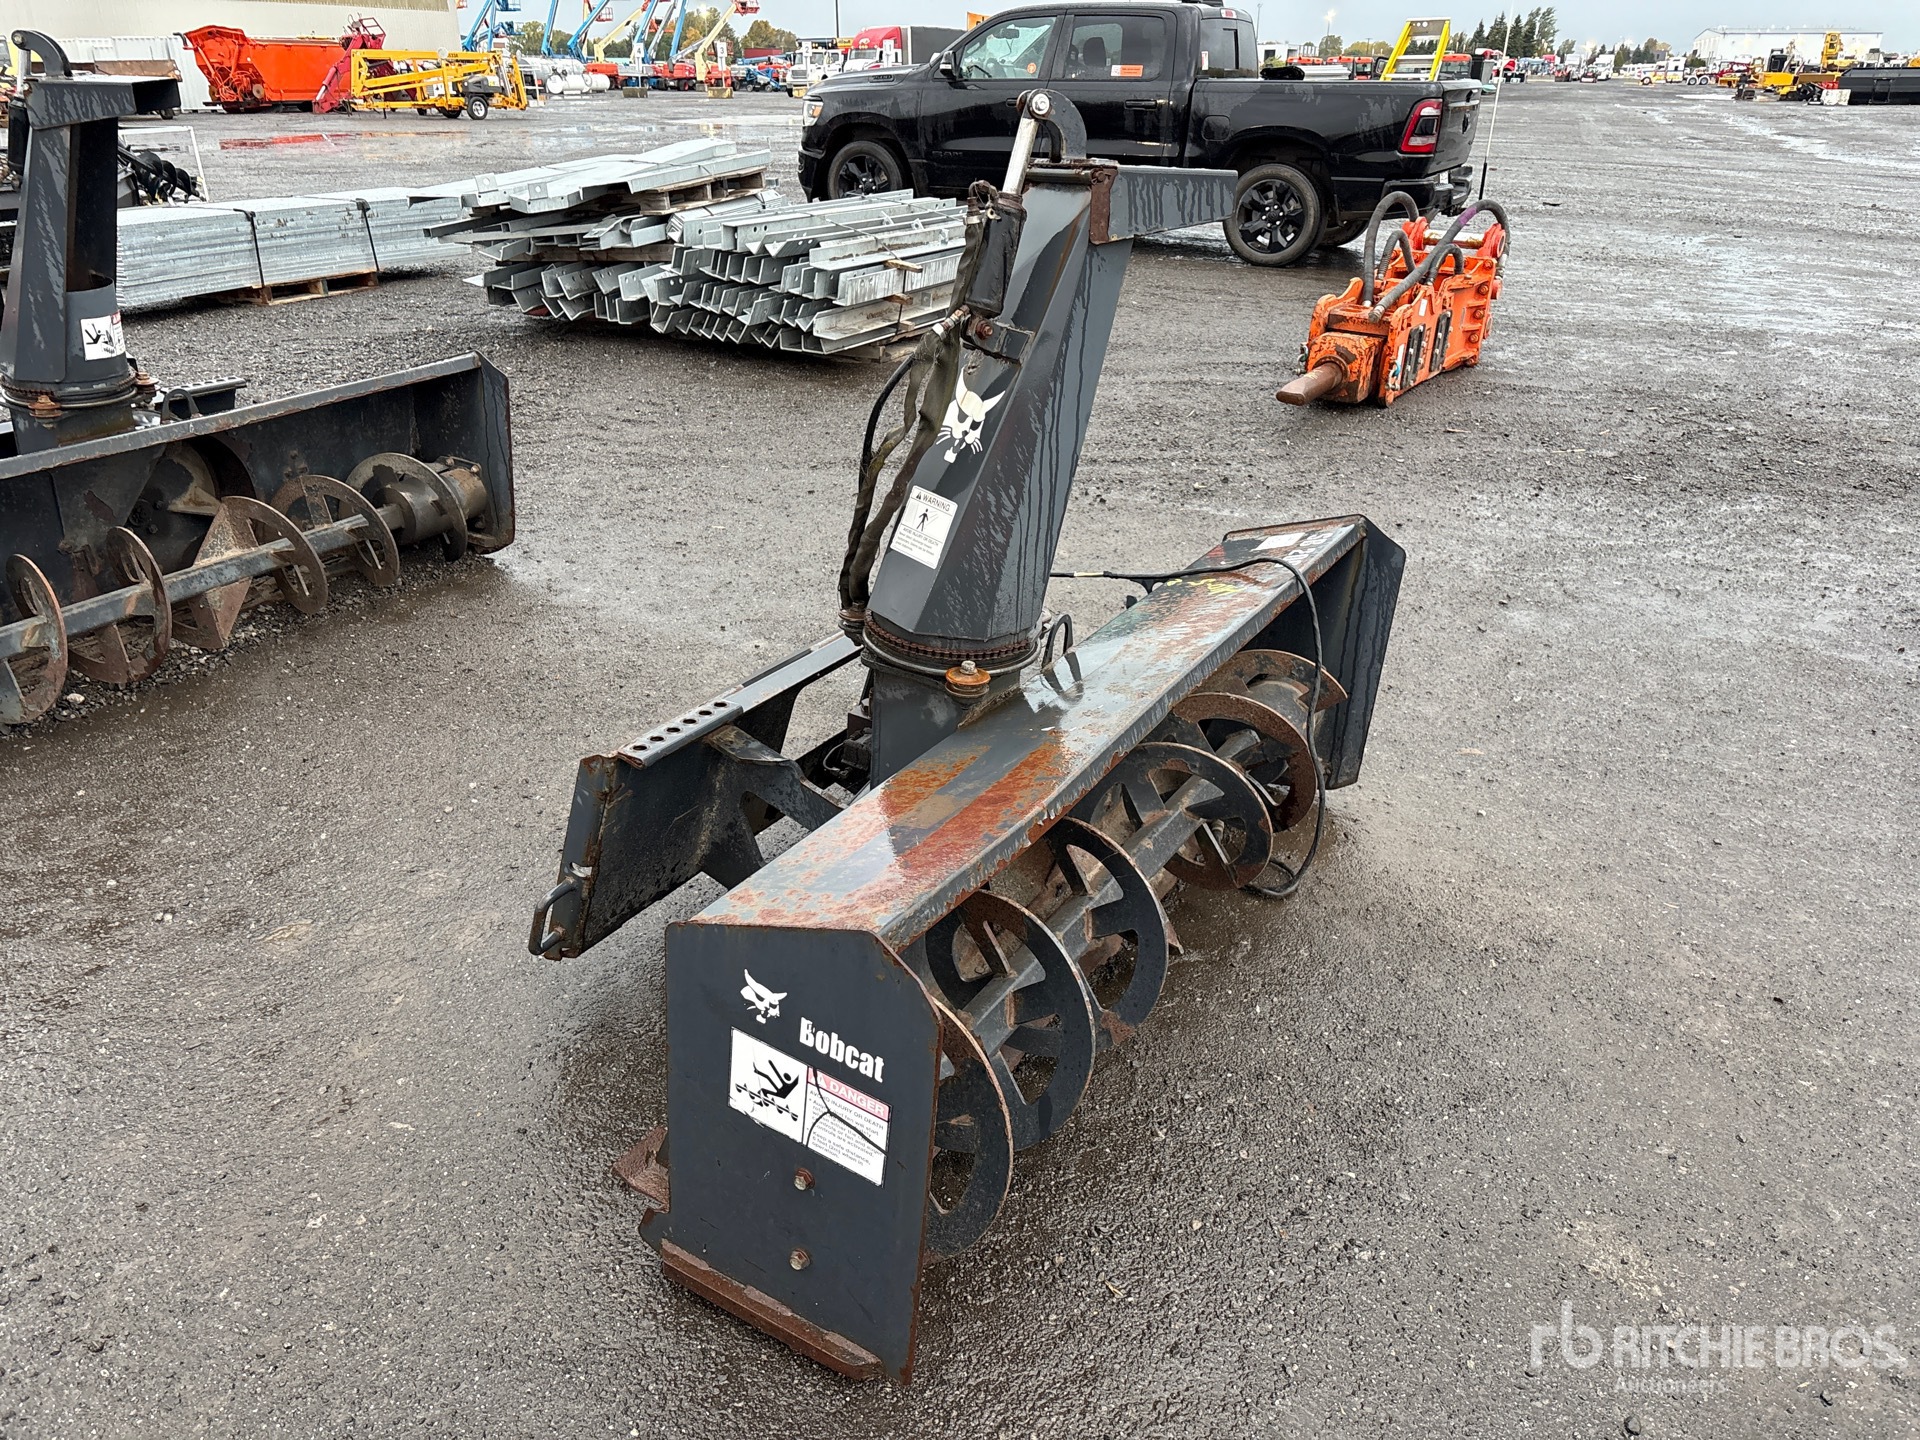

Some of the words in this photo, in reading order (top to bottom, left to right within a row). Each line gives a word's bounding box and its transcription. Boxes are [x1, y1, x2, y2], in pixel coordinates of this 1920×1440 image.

[922, 494, 951, 512] WARNING
[800, 1017, 884, 1083] Bobcat
[830, 1078, 886, 1118] DANGER
[830, 1099, 852, 1114] INJURY
[853, 1110, 862, 1120] OR
[863, 1116, 883, 1130] DEATH
[812, 1130, 826, 1141] Keep
